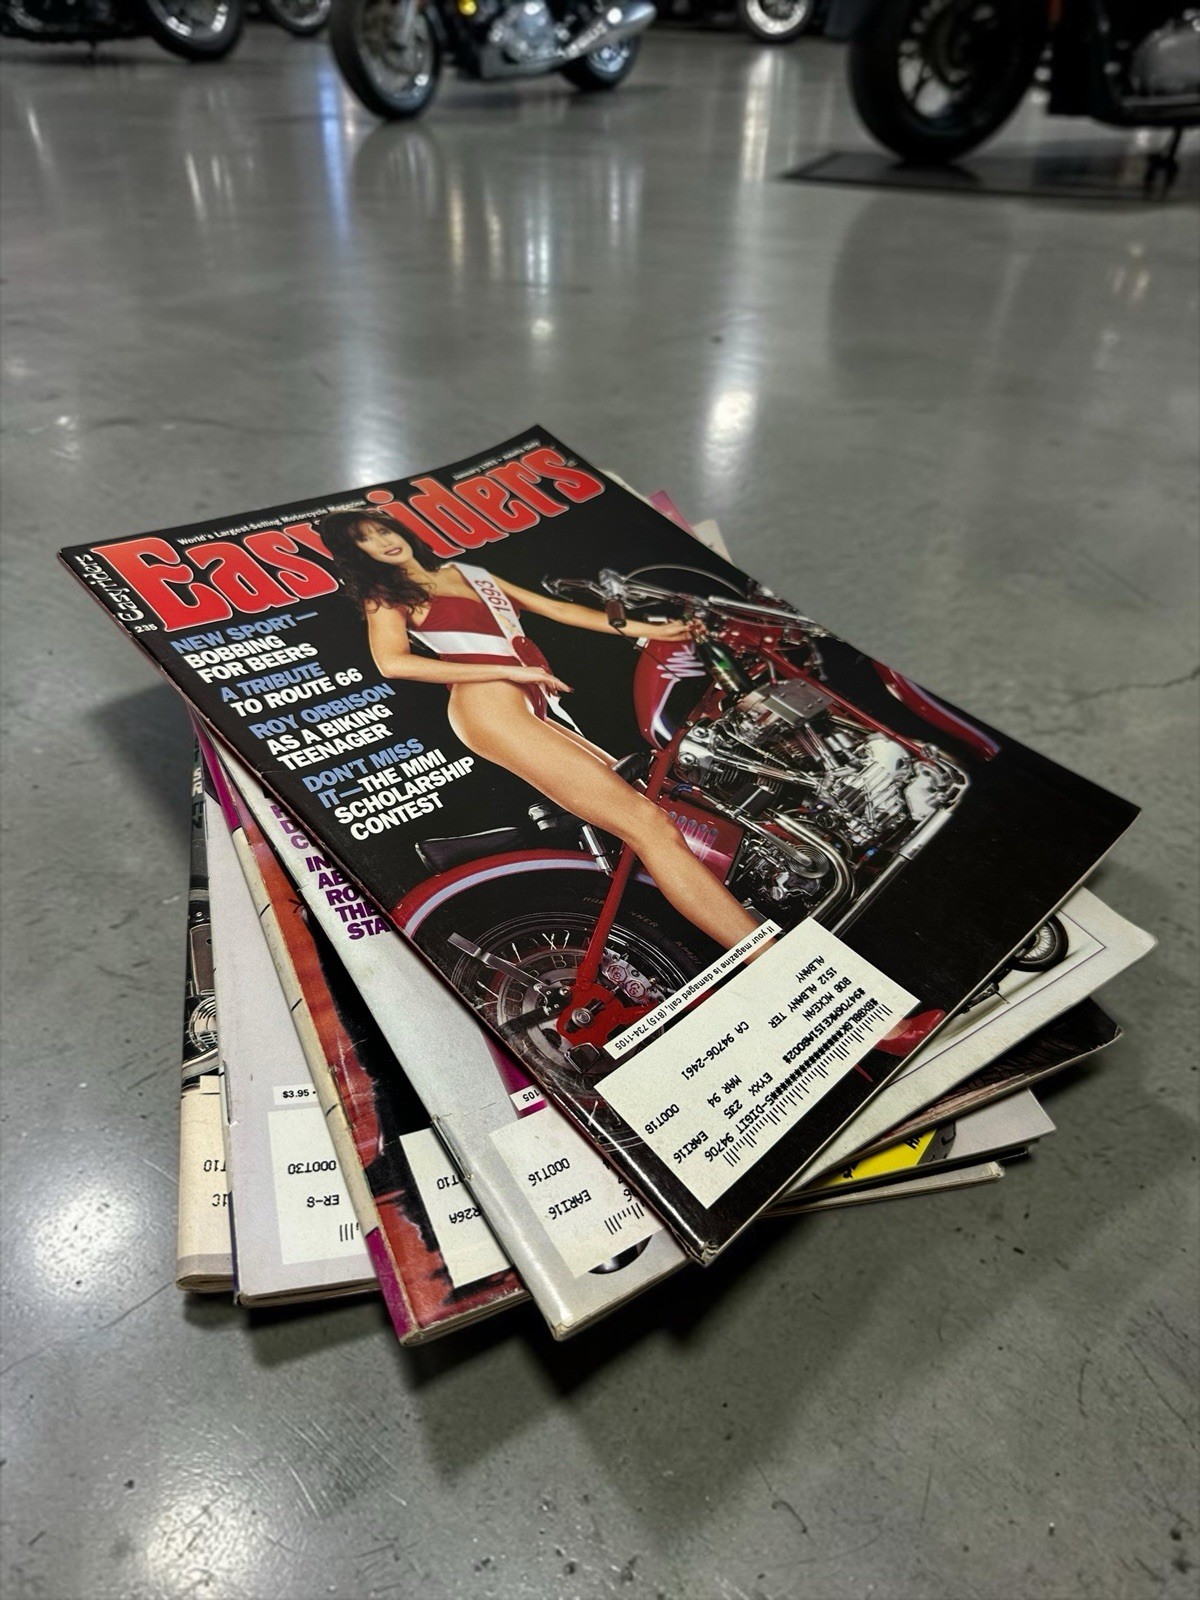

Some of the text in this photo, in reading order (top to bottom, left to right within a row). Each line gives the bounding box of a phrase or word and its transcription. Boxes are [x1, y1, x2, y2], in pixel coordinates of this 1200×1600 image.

[176, 532, 215, 546] World's
[474, 580, 511, 612] 1993
[134, 623, 158, 633] 235
[171, 630, 224, 655] NEW
[182, 635, 286, 669] BOBBING
[196, 643, 318, 684] FOR BEERS
[220, 662, 325, 702] A TRIBUTE
[230, 668, 363, 717] TO ROUTE 66
[248, 682, 396, 740] ROY ORBISON
[266, 703, 393, 756] AS A BIKING
[277, 723, 393, 771] TEENAGER
[302, 738, 424, 793] DON'T MISS
[398, 748, 448, 776] MMI
[334, 756, 475, 824] SCHOLARSHIP
[350, 792, 445, 841] CONTEST
[752, 930, 767, 944] your
[721, 943, 752, 968] magazine
[682, 974, 713, 1000] damaged
[818, 967, 837, 984] 1512
[665, 998, 681, 1010] call,
[788, 984, 817, 1012] ALBANY
[647, 1009, 666, 1026] (815)
[681, 956, 824, 1080] ALBANY CA 94706-2461
[768, 1013, 787, 1028] TER
[615, 1025, 648, 1050] 734-1105
[707, 977, 852, 1107] BOB MCKEAN MAR 94
[282, 1089, 310, 1099] $3.95
[748, 1072, 773, 1096] EYXX
[724, 1100, 742, 1119] 235
[674, 1131, 708, 1163] EARI16
[705, 1132, 734, 1162] 94706
[548, 1189, 592, 1220] EARI16
